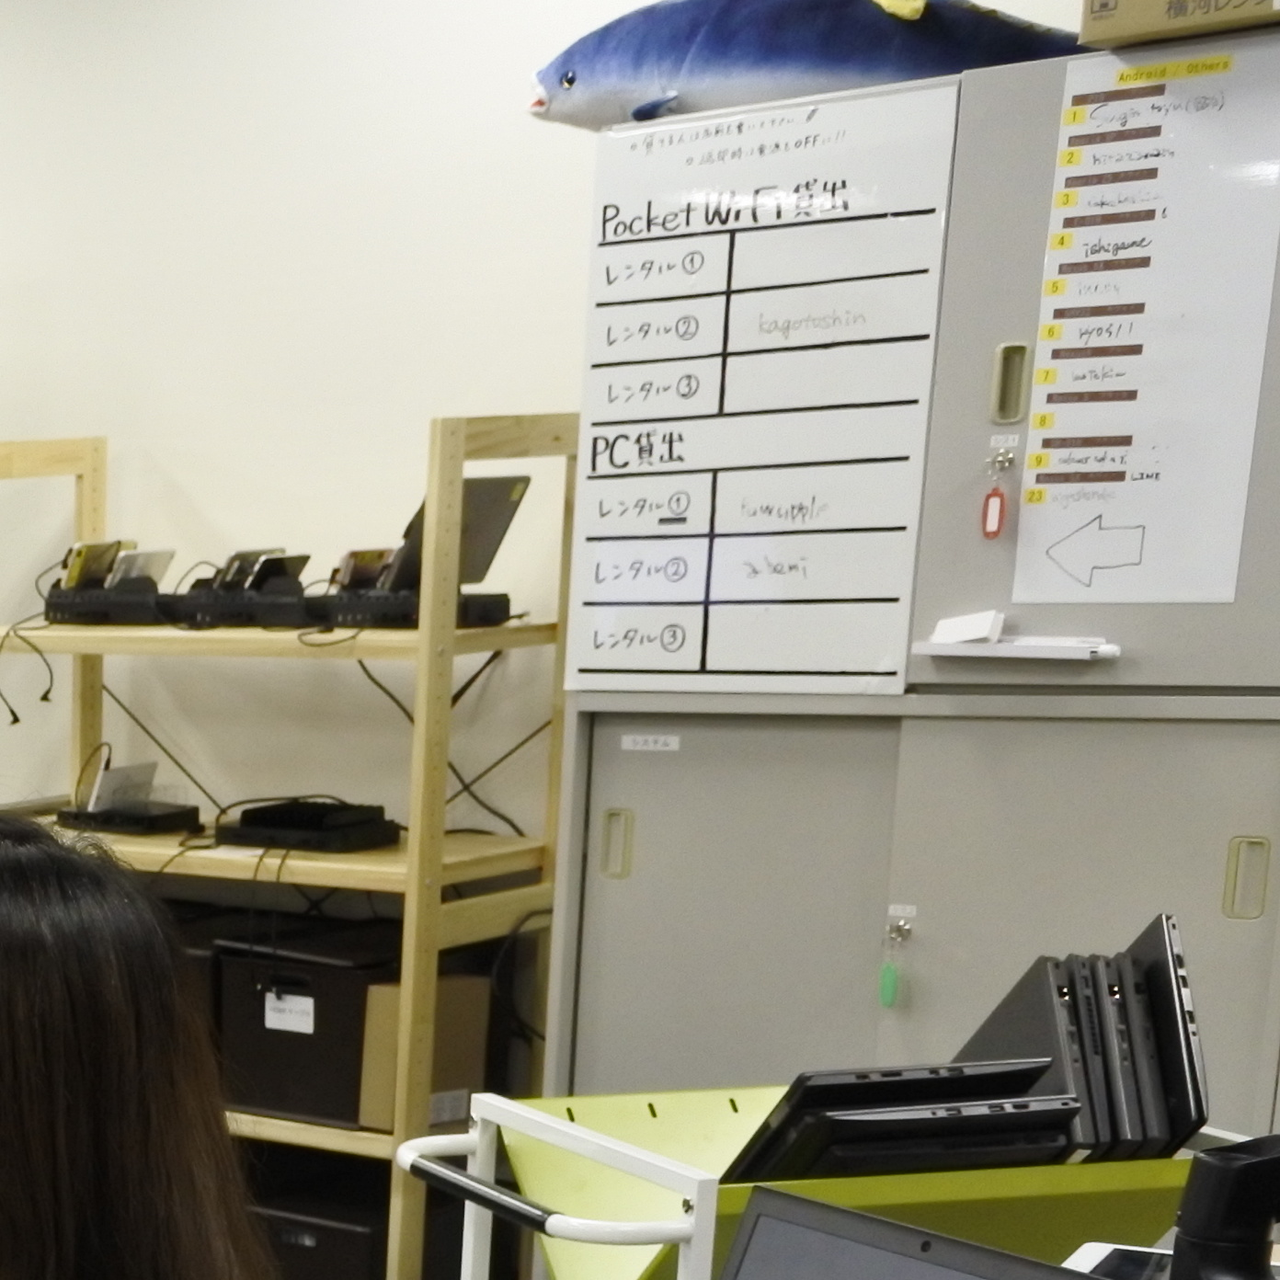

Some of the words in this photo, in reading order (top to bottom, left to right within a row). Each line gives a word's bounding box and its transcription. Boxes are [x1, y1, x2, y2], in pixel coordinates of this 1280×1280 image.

[1117, 67, 1166, 83] Android
[1186, 60, 1230, 74] Others
[1066, 152, 1074, 164] 2
[1062, 193, 1070, 205] 3
[602, 200, 696, 242] Pocket
[1057, 235, 1065, 247] 4
[1051, 281, 1059, 293] 5
[1047, 326, 1055, 338] 6
[1043, 370, 1050, 382] 7
[1039, 415, 1046, 427] 8
[590, 430, 685, 472] PC貸出
[1035, 454, 1042, 466] 9
[1028, 490, 1043, 502] 23
